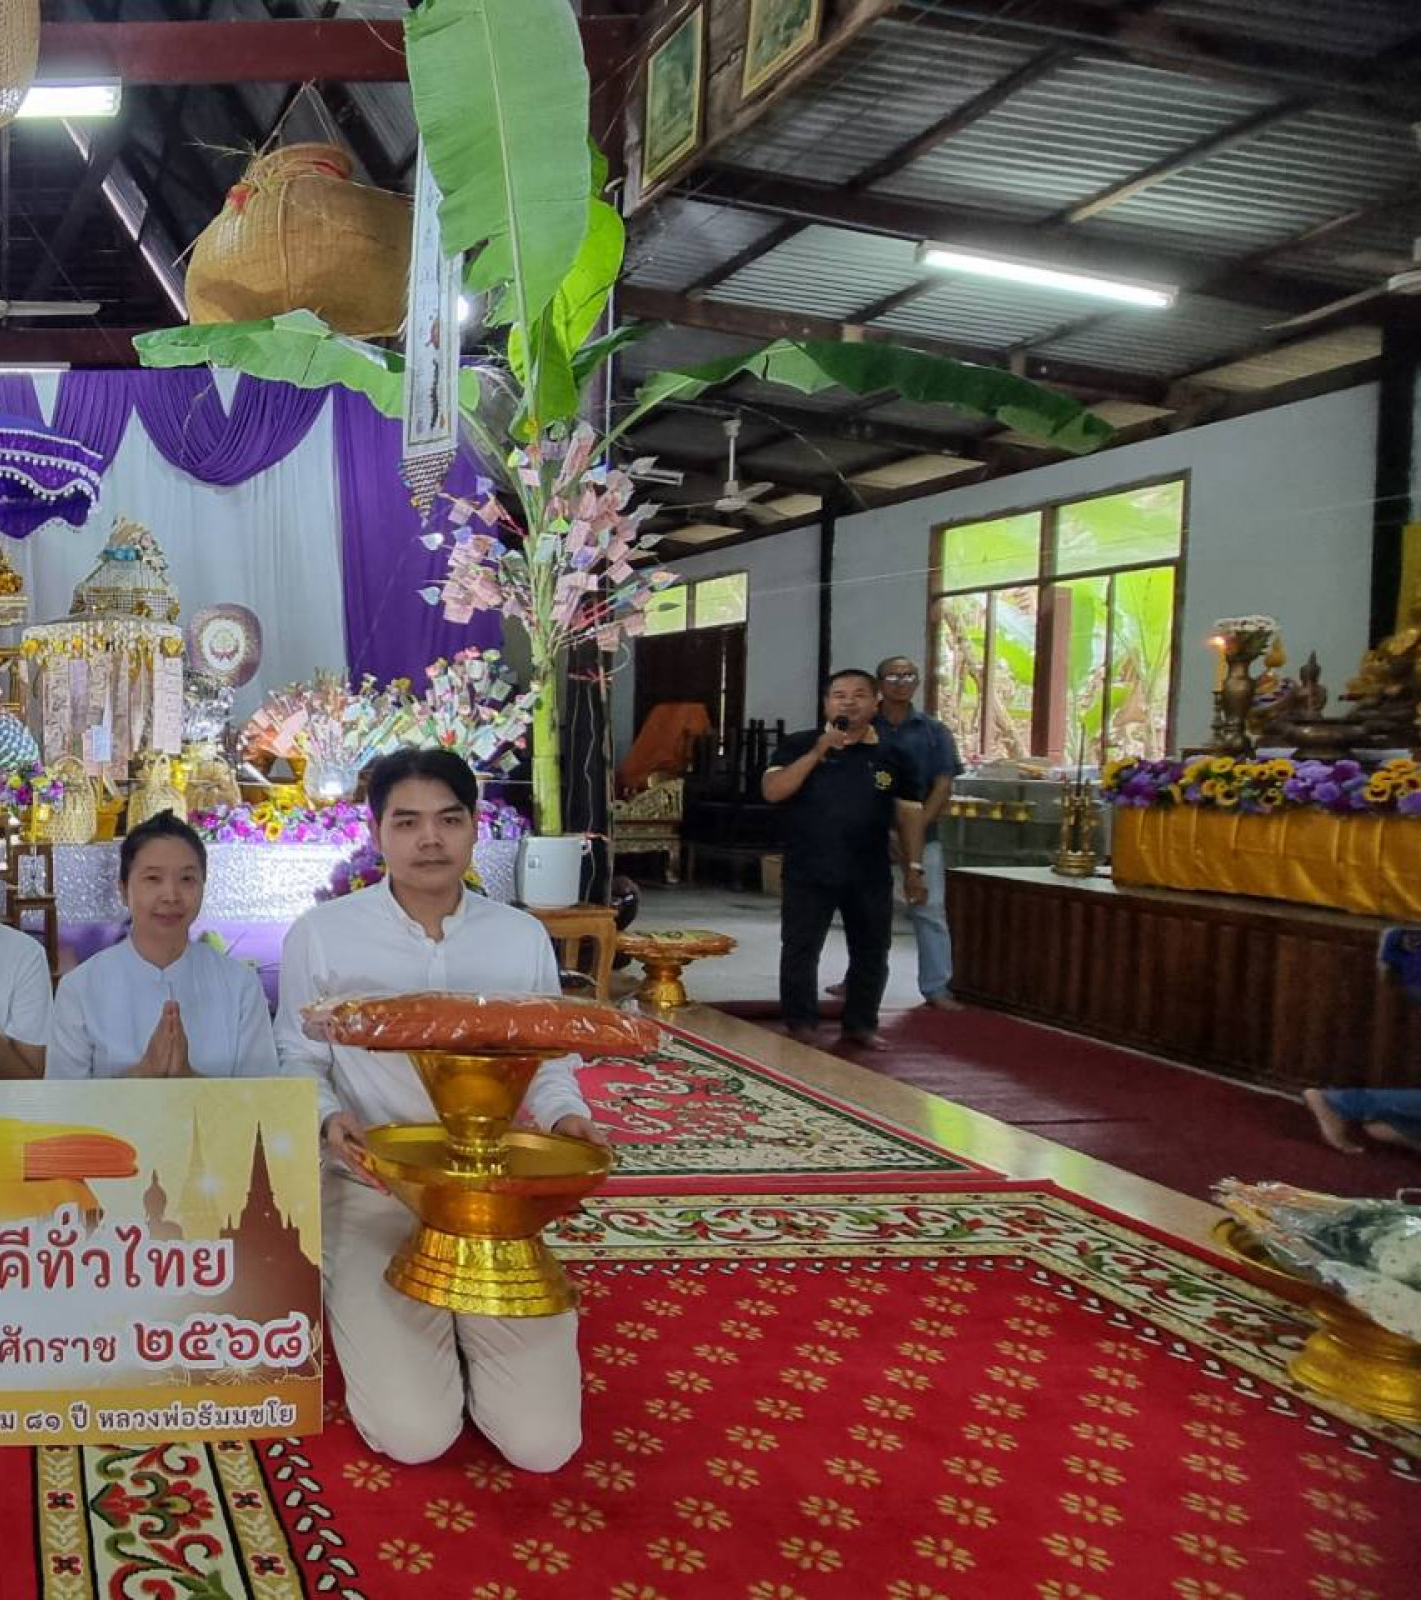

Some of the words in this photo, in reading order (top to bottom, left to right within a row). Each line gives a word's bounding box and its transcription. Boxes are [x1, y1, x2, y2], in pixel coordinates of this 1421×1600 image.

[133, 1319, 303, 1362] ๒๕๖๘
[25, 1412, 61, 1430] ๘๑
[71, 1404, 88, 1429] ปี
[98, 1400, 296, 1429] หลวงพ่อธัมมชโย
